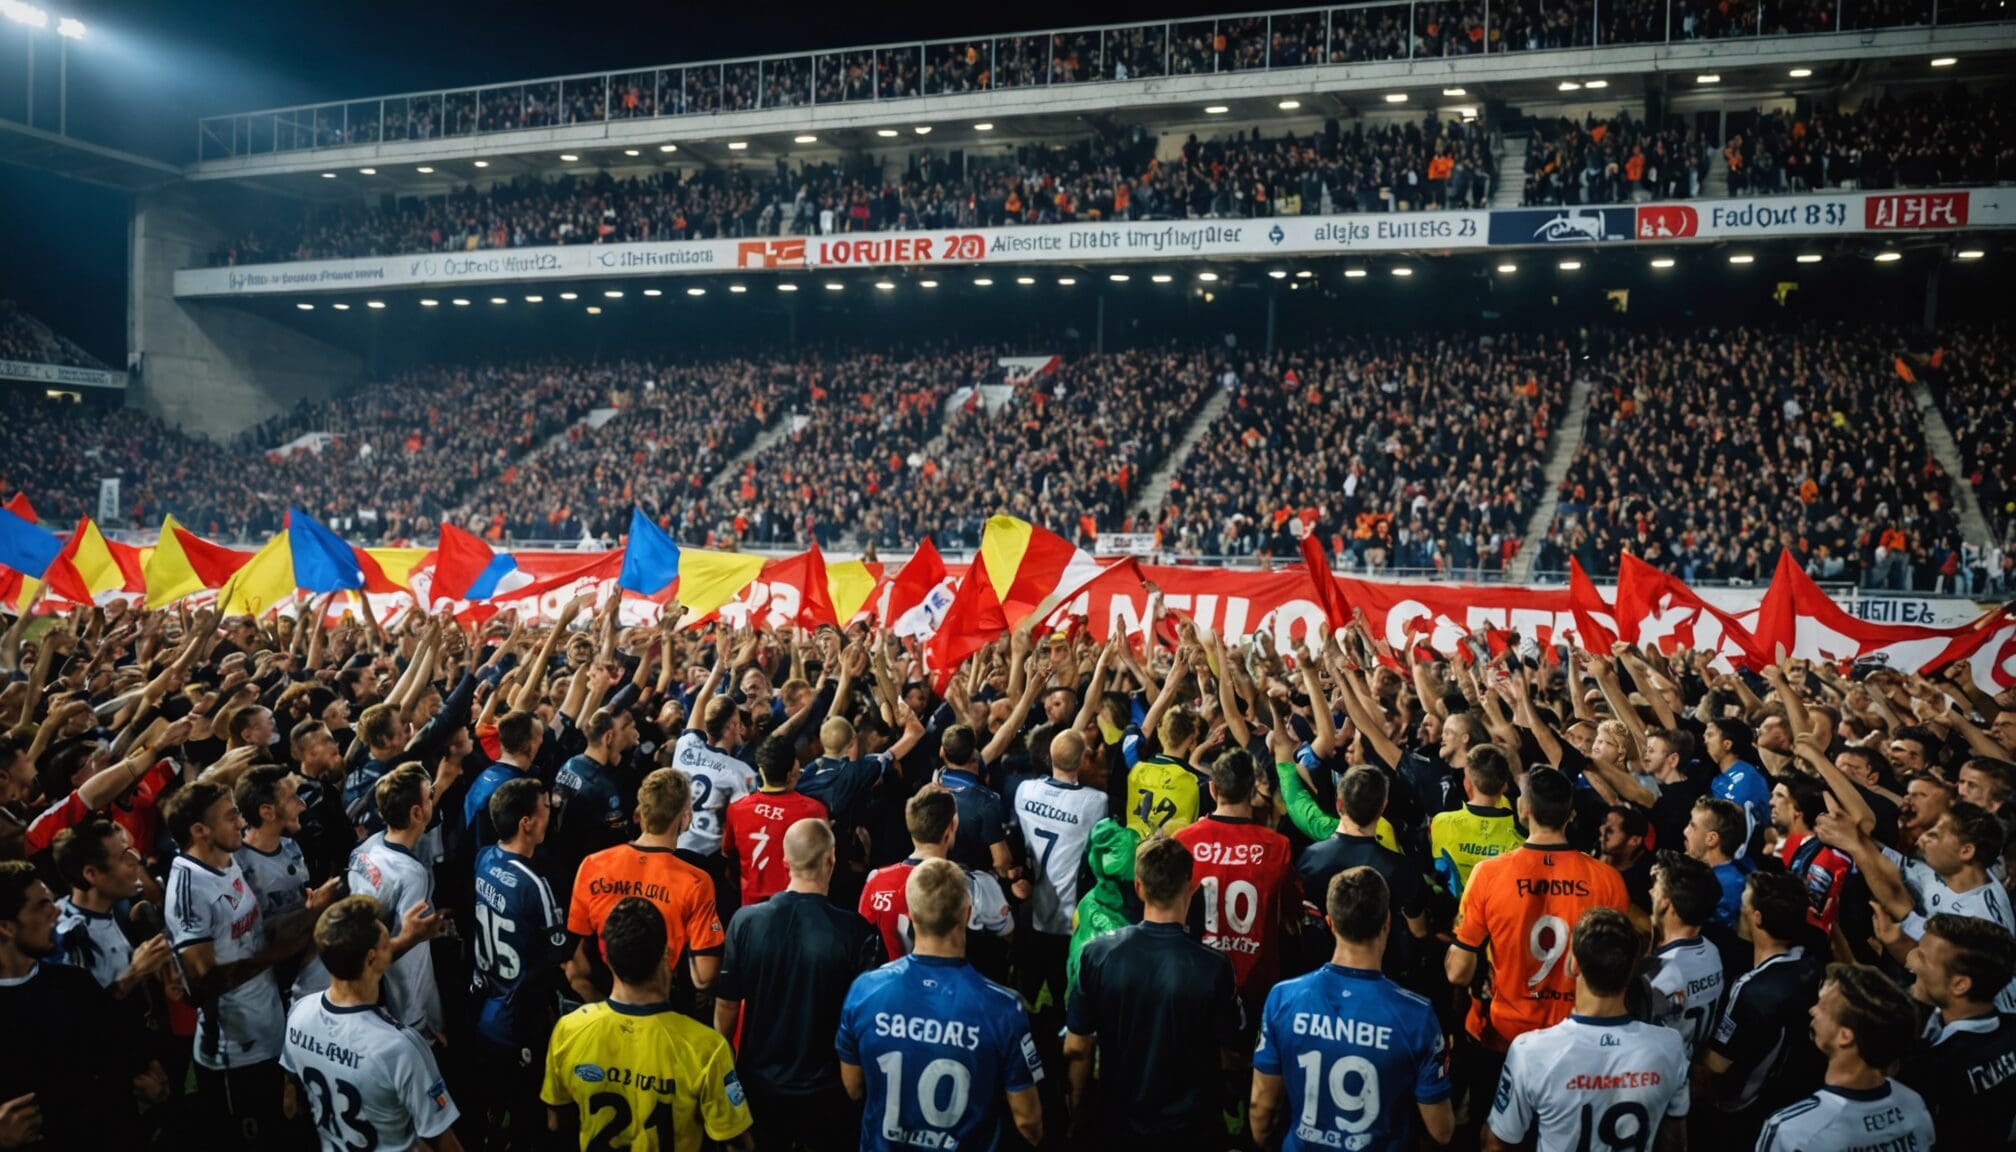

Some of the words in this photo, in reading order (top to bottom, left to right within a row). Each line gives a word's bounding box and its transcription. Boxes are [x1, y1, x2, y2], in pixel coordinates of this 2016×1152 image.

[1034, 826, 1059, 872] 7
[1200, 875, 1259, 935] 10
[876, 1049, 972, 1132] 10
[1296, 1050, 1381, 1134] 19
[589, 1091, 676, 1152] 21
[1576, 1101, 1652, 1152] 19
